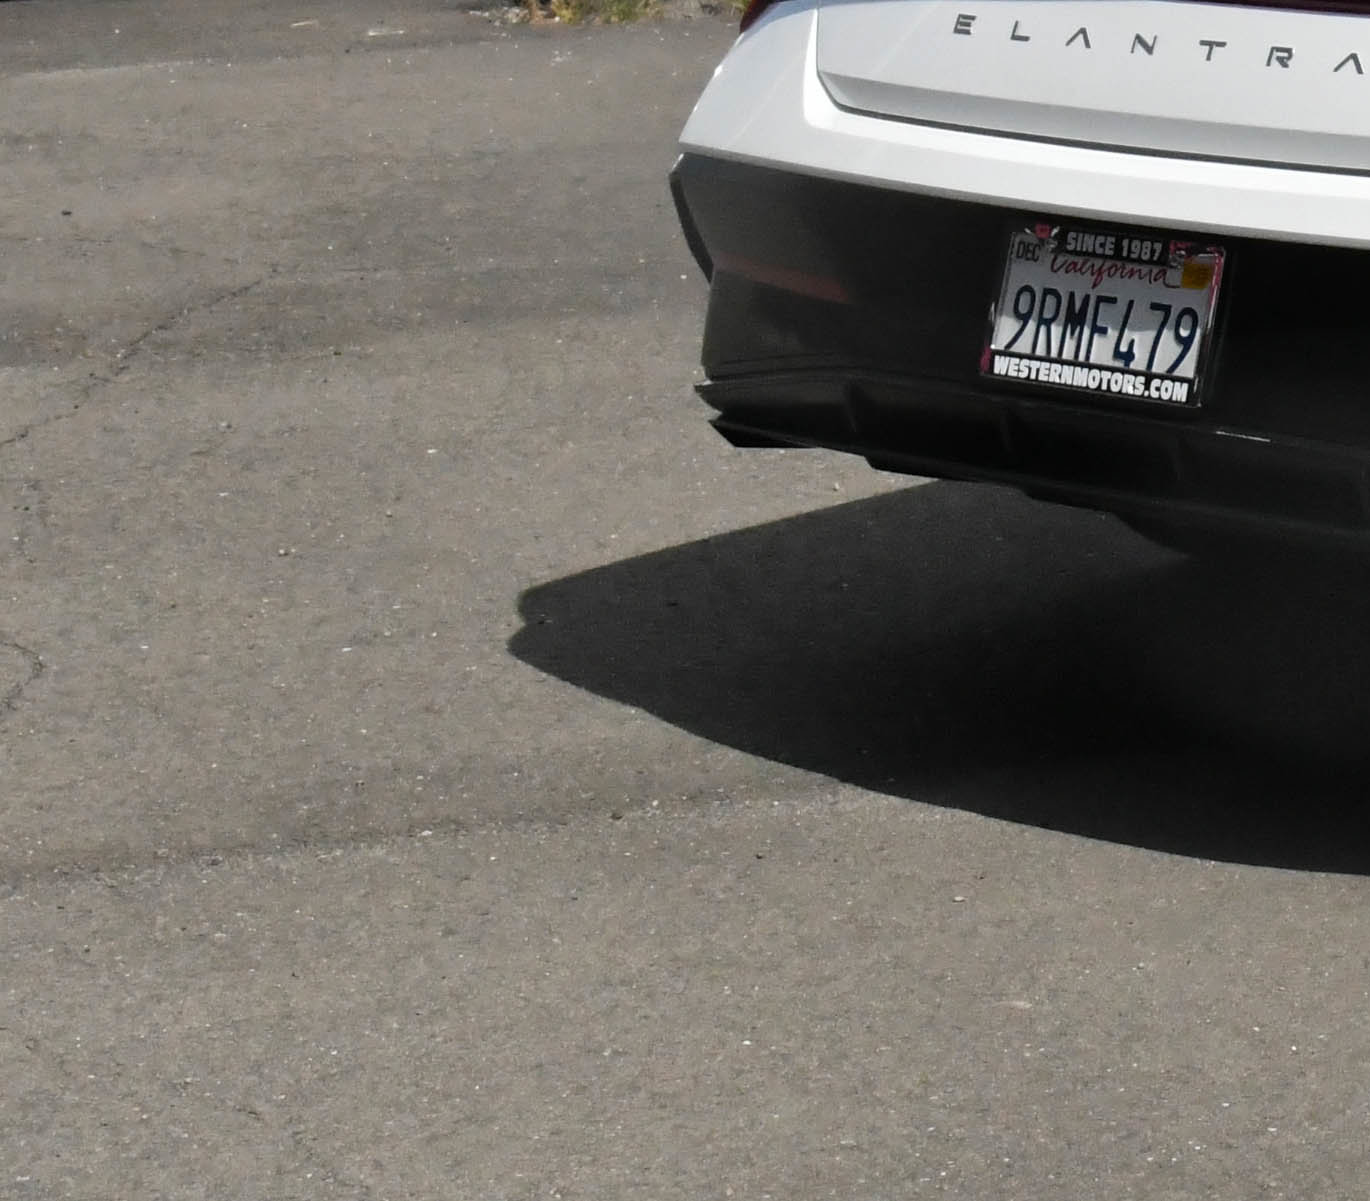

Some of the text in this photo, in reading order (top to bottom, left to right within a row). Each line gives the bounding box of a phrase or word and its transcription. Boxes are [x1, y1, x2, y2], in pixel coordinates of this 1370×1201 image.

[953, 14, 1364, 75] ELANTRA
[1066, 232, 1163, 262] SINCE 1987
[1050, 253, 1181, 289] California
[1004, 285, 1199, 374] 9RMF479
[993, 355, 1188, 402] WESTERNMOTORS.COM
